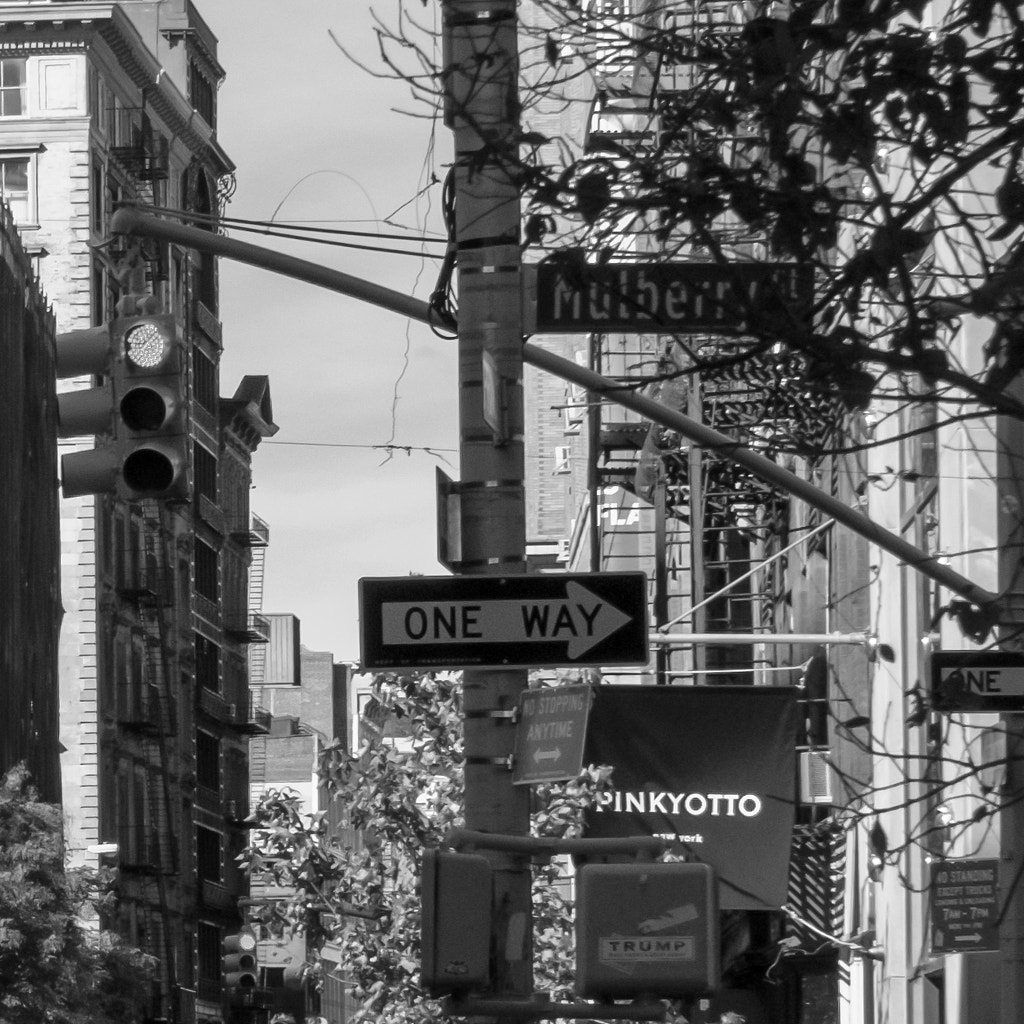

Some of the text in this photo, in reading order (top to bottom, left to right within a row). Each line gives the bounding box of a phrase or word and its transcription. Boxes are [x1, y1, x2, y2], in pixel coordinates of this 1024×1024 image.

[404, 603, 603, 640] ONE WAY
[538, 694, 584, 714] STOPPING
[526, 720, 574, 741] ANYTIME
[595, 791, 762, 817] PINKYOTTO
[609, 940, 687, 952] TRUMP
